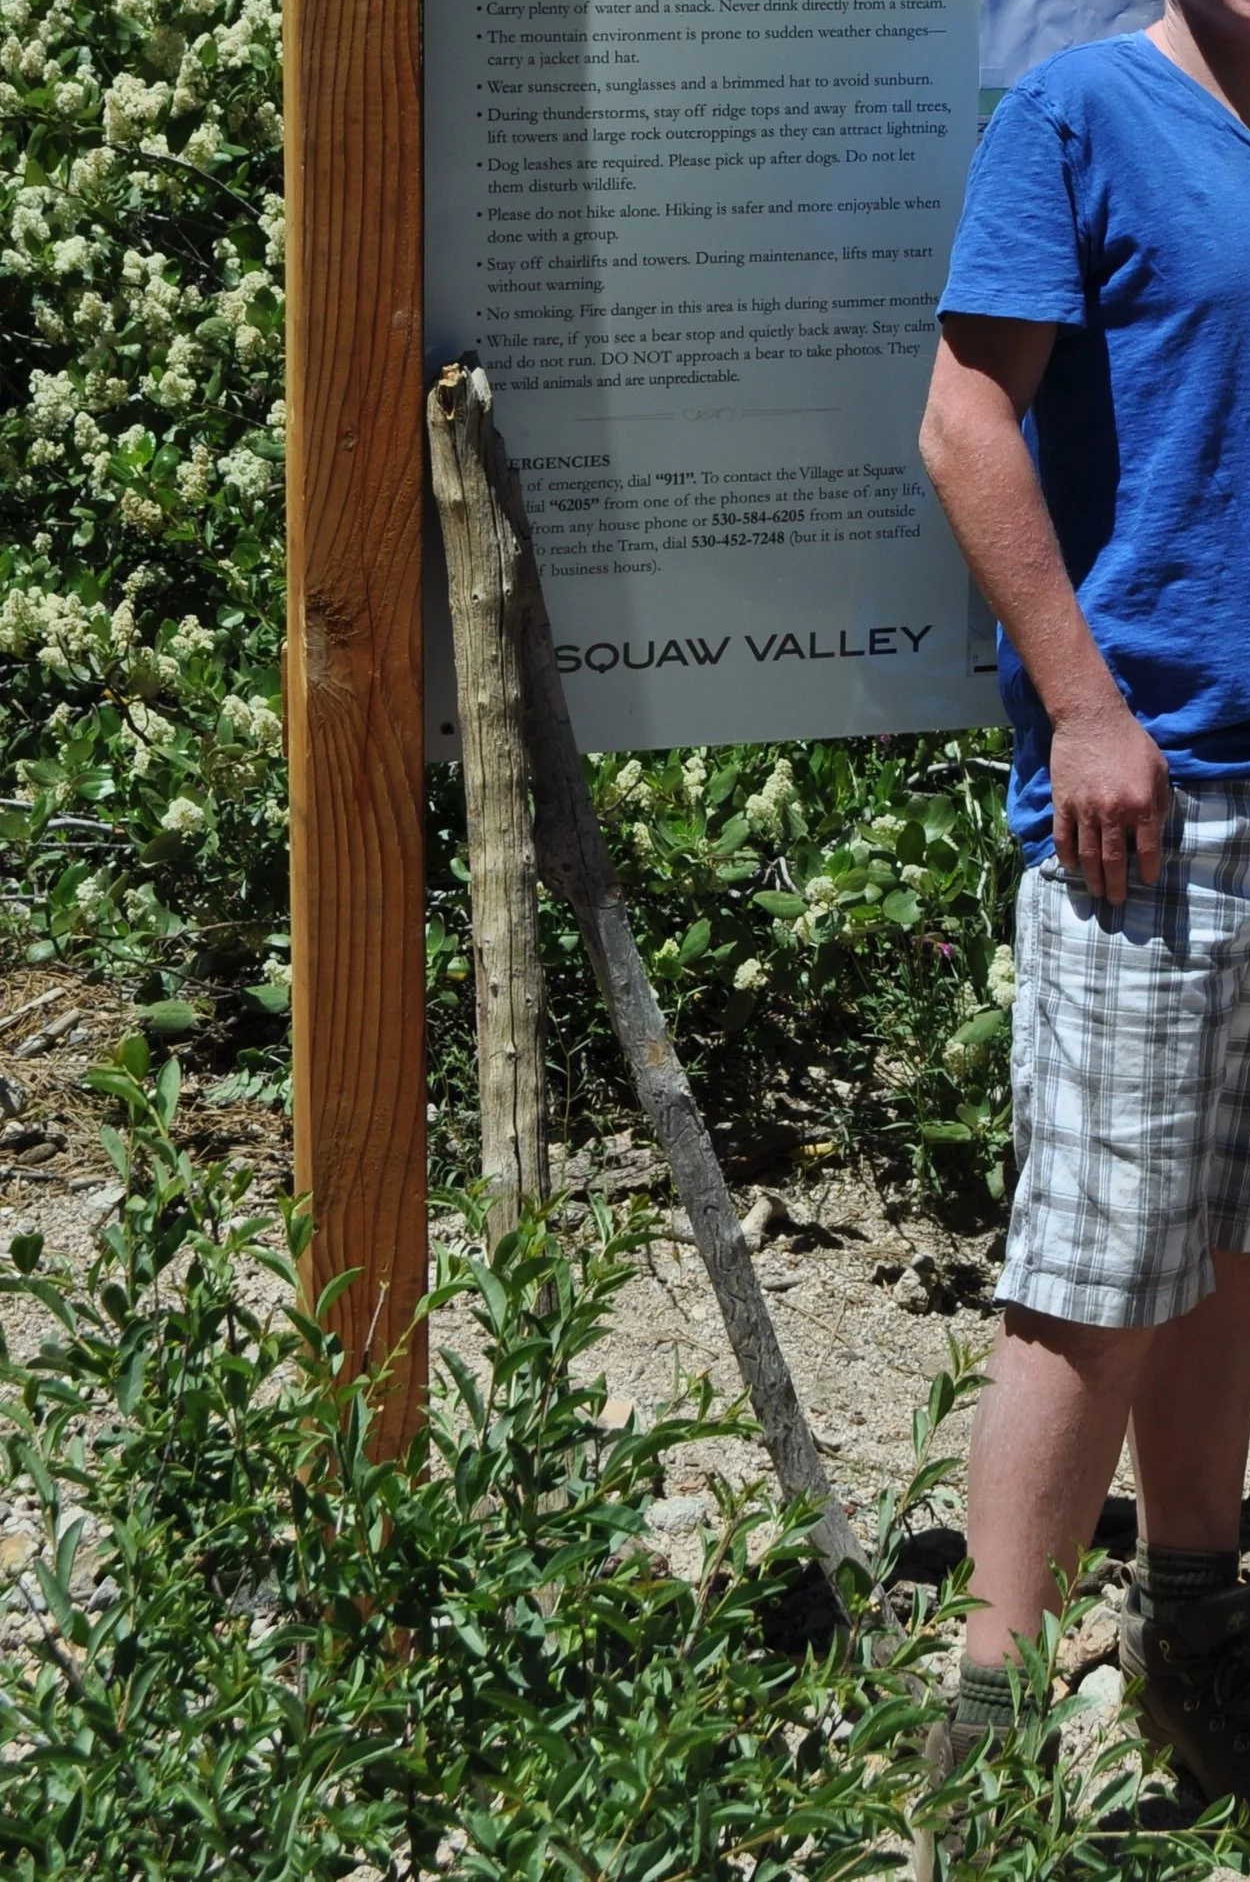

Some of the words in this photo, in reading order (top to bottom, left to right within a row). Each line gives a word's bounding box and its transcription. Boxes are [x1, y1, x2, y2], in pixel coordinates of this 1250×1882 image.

[485, 0, 525, 19] Carry
[528, 0, 570, 20] plenty
[572, 0, 590, 14] of
[593, 3, 632, 14] water
[634, 0, 659, 14] and
[888, 0, 896, 9] a
[485, 77, 524, 94] Wear
[527, 81, 601, 95] sunscreen,
[605, 76, 676, 95] sunglasses
[677, 75, 706, 90] and
[710, 77, 720, 89] a
[719, 72, 784, 91] brimmed
[786, 73, 813, 88] hat
[812, 77, 829, 87] to
[832, 72, 871, 86] avoid
[871, 71, 933, 86] sunburn.
[485, 256, 516, 275] Stay
[519, 255, 543, 270] off
[547, 253, 608, 270] chairlifts
[611, 252, 638, 267] and
[639, 253, 691, 266] towers.
[695, 246, 745, 268] During
[746, 247, 838, 265] maintenance,
[841, 245, 867, 260] lifts
[870, 248, 901, 263] may
[903, 246, 933, 258] start
[507, 454, 611, 471] ERGENCIES
[526, 472, 544, 493] of
[547, 478, 623, 495] emergency,
[625, 473, 651, 488] dial
[655, 471, 697, 486] “911”.
[699, 470, 719, 484] To
[723, 471, 774, 485] contact
[774, 466, 797, 481] the
[798, 464, 844, 483] Village
[847, 467, 861, 477] at
[862, 460, 906, 481] Squaw
[529, 515, 565, 536] from
[568, 521, 595, 537] any
[597, 516, 642, 531] house
[644, 514, 688, 533] phone
[689, 517, 708, 527] or
[711, 506, 805, 526] 530-584-6205
[807, 506, 842, 521] from
[844, 509, 863, 519] an
[866, 500, 915, 519] outside
[554, 636, 732, 674] SQUAW
[744, 624, 934, 663] VALLEY
